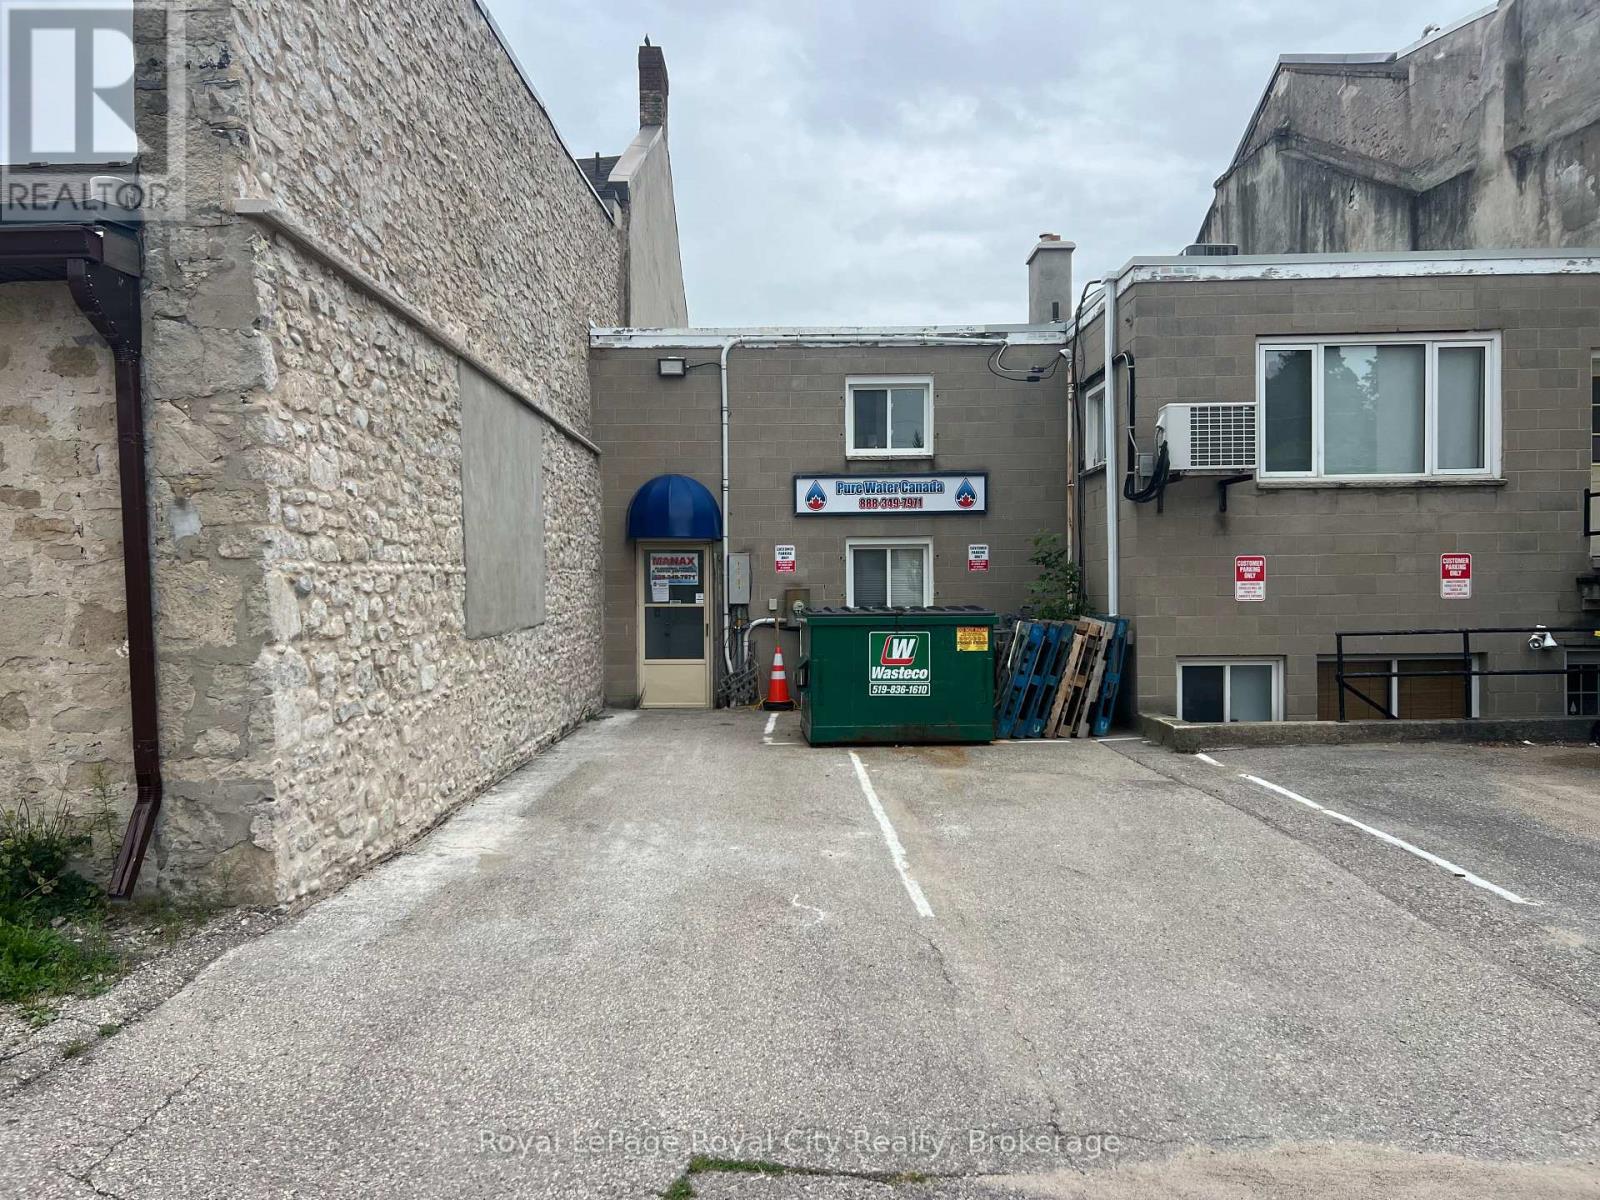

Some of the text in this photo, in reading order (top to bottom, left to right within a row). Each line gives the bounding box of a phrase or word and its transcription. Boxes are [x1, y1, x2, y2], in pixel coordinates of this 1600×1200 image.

[836, 480, 945, 495] Pure Water Canada
[858, 497, 924, 510] 888-349-7971
[871, 666, 928, 680] Wasteco
[872, 685, 928, 695] 519-836-1610
